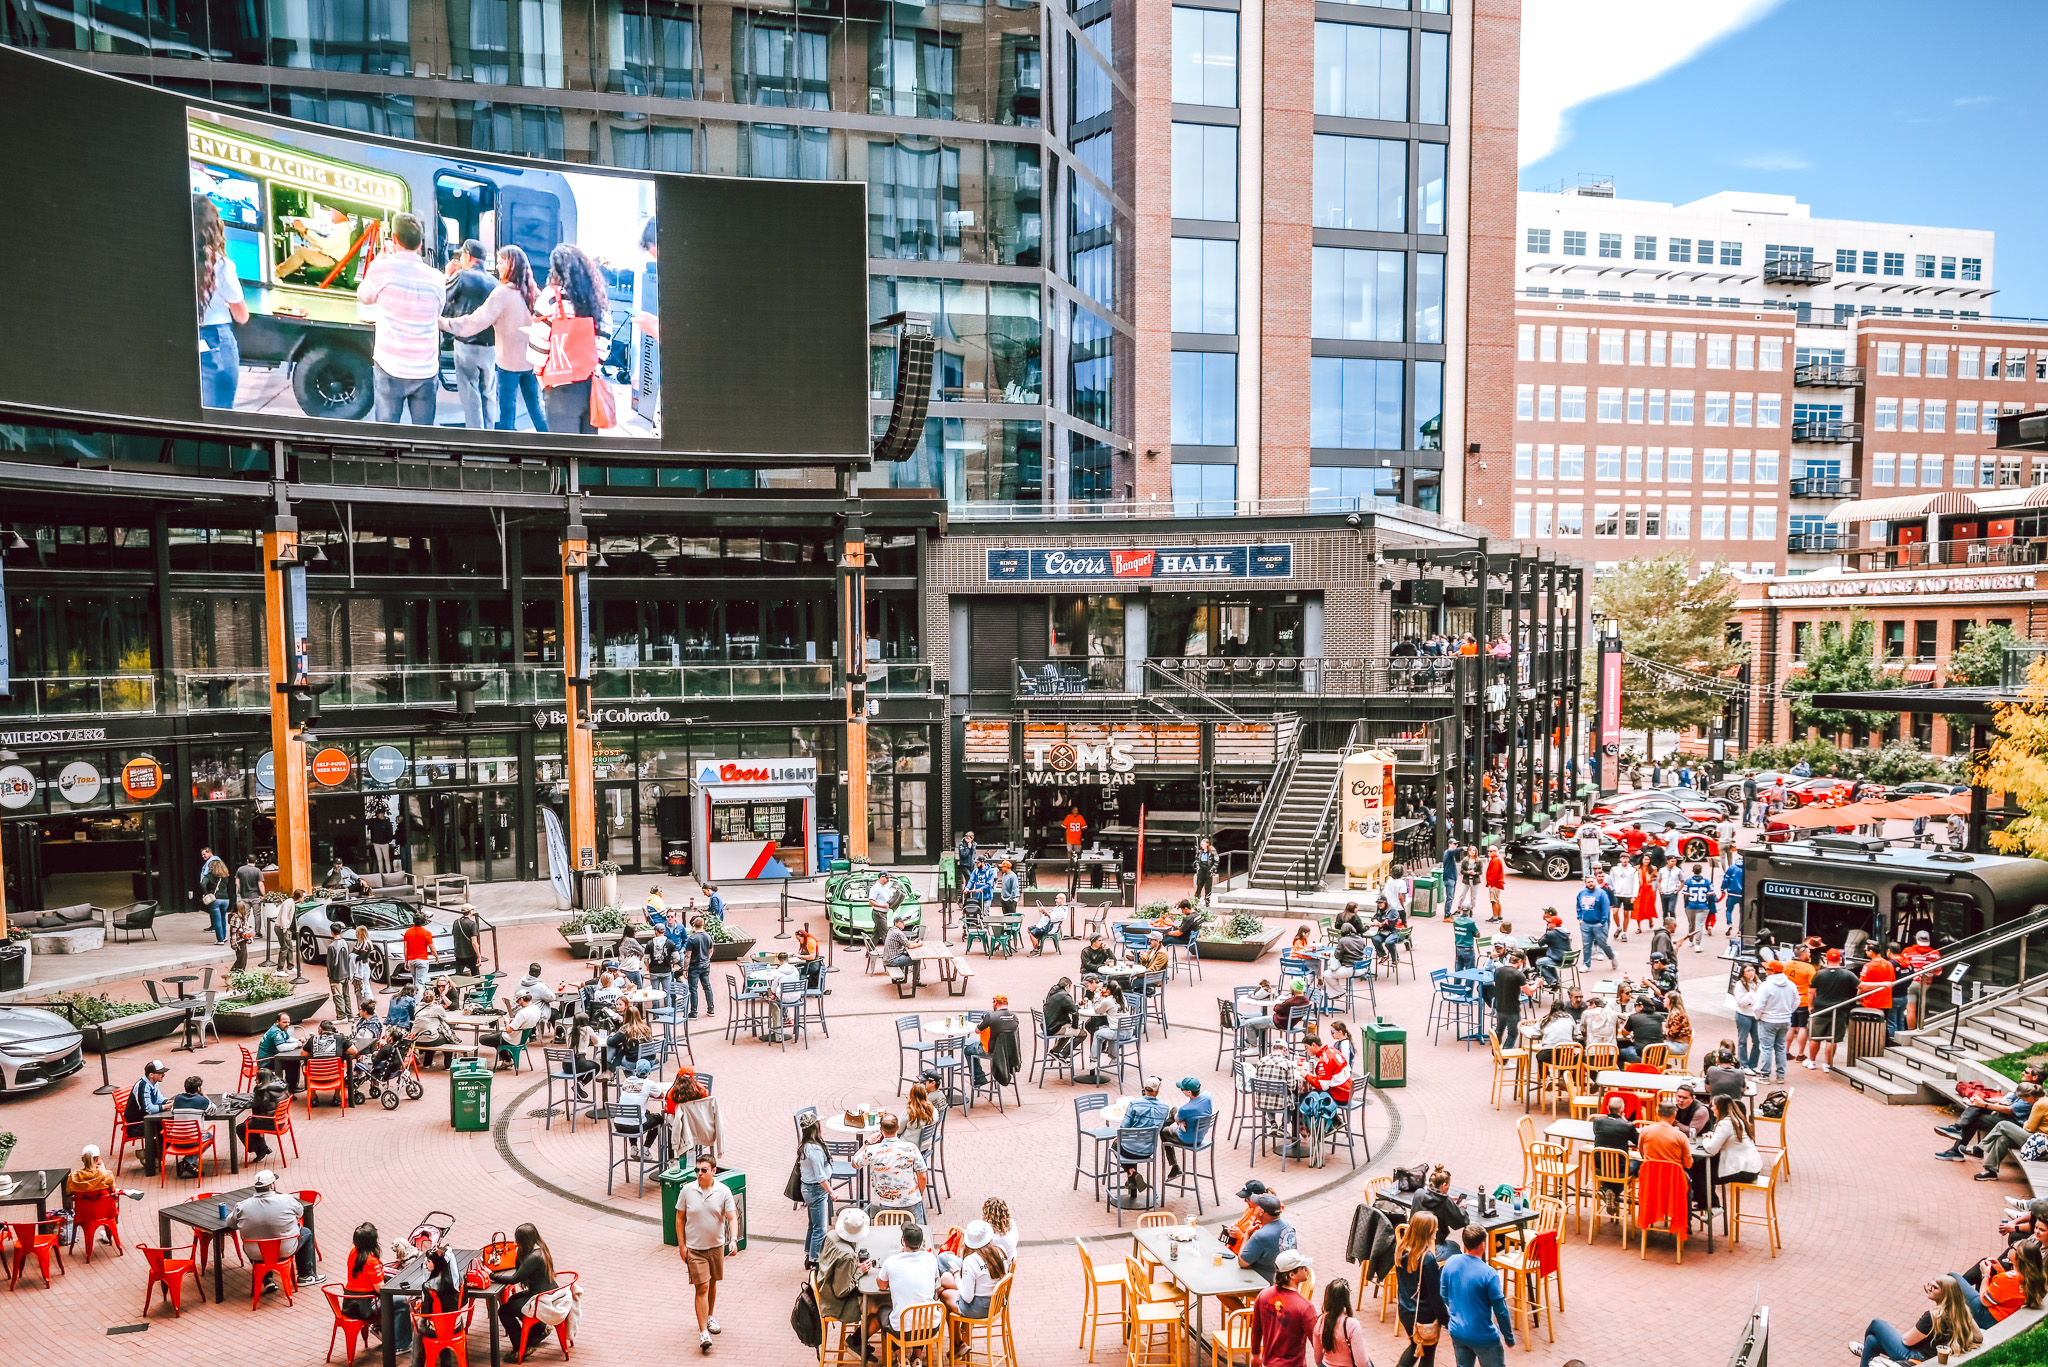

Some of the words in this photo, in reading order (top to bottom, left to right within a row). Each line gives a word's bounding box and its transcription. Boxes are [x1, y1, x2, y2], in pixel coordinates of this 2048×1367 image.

[189, 133, 252, 165] ENVER
[259, 152, 327, 184] RACING
[333, 173, 395, 199] SOCIAL
[1044, 551, 1106, 575] Coors
[1115, 552, 1152, 575] Banquet
[1160, 555, 1231, 574] HALL
[1914, 578, 1947, 593] AND
[590, 709, 603, 723] of
[605, 707, 670, 723] Colorado
[0, 731, 66, 745] MILEPOST
[719, 763, 770, 781] Coors
[771, 767, 816, 780] LIGHT
[1026, 771, 1090, 784] WATCH
[1099, 772, 1135, 785] BAR
[1351, 780, 1384, 796] Coor
[1070, 823, 1081, 832] 58
[1688, 886, 1708, 902] 56
[1768, 884, 1801, 895] DENVER
[1803, 888, 1836, 899] RACING
[1839, 893, 1871, 904] SOCIAL
